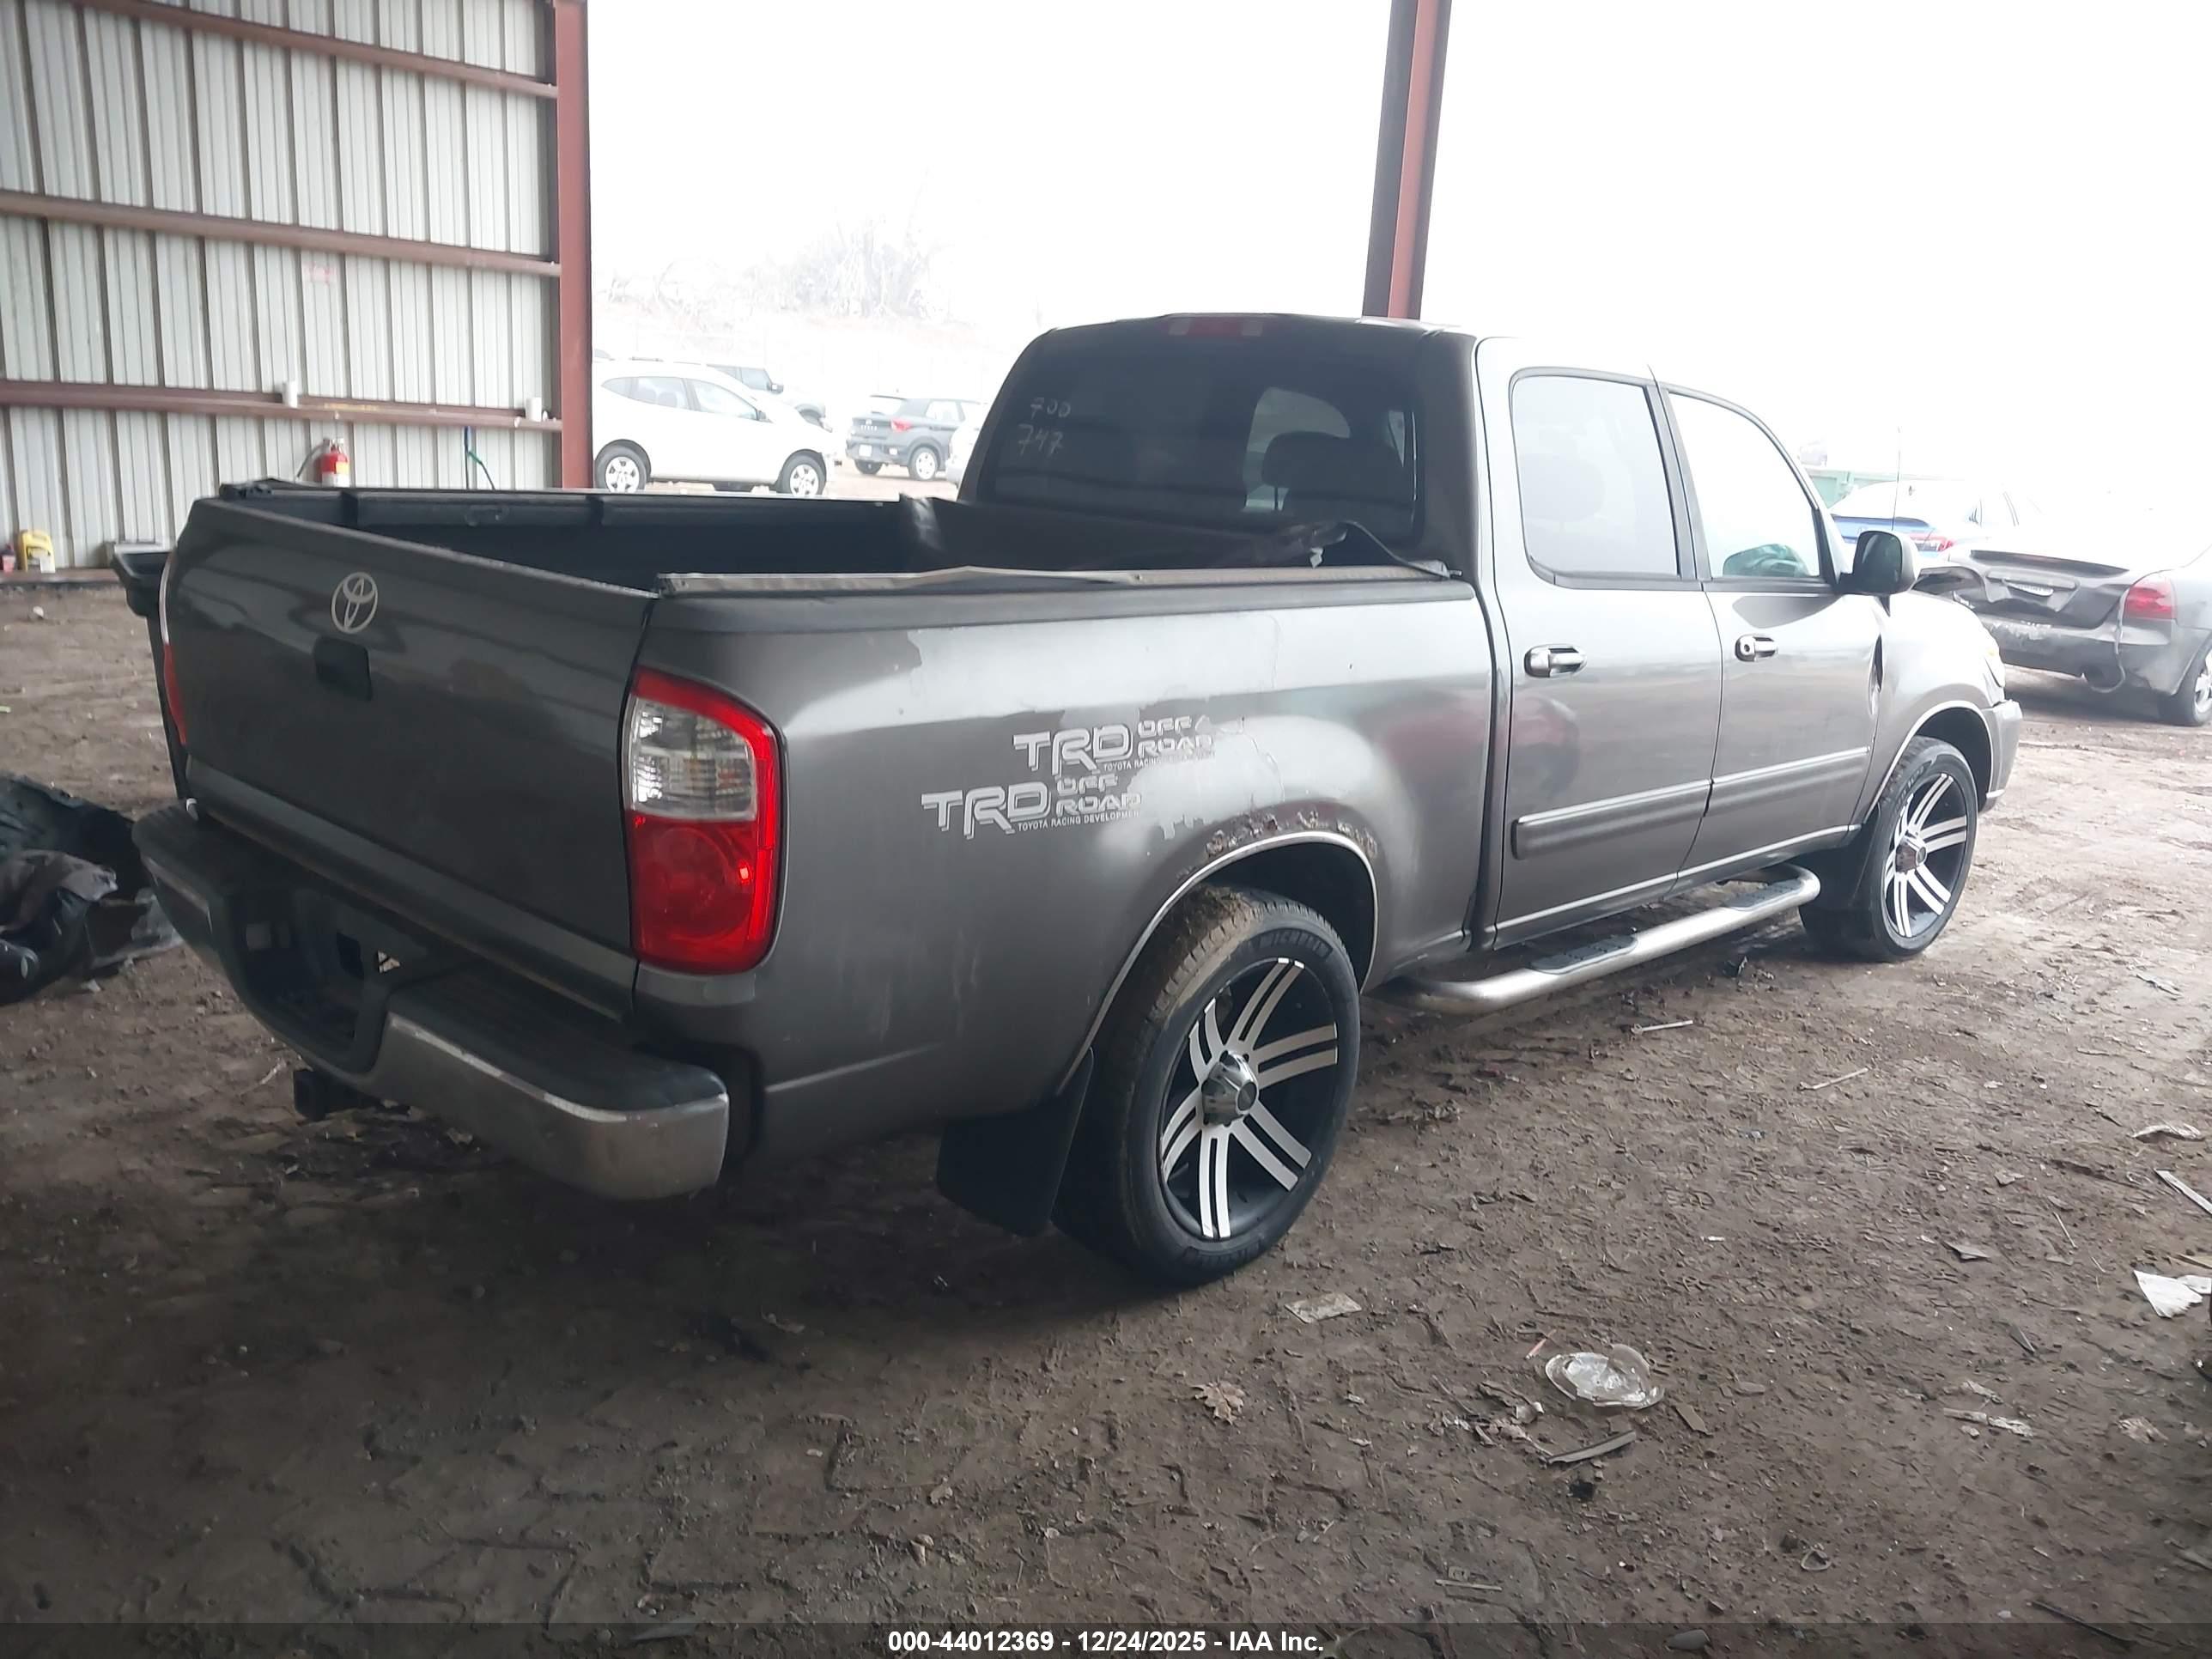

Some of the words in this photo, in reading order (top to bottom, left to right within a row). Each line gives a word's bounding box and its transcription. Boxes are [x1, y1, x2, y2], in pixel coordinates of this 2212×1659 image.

[1138, 715, 1192, 738] OFF
[1013, 724, 1133, 780] TRD
[1138, 734, 1214, 758] ROAD
[1103, 760, 1132, 771] TOYOTA
[1057, 773, 1118, 797] OFF
[921, 781, 1052, 840] TRD
[1055, 792, 1141, 817] ROAD
[1018, 821, 1048, 832] TOYOTA
[1050, 814, 1081, 828] RACING
